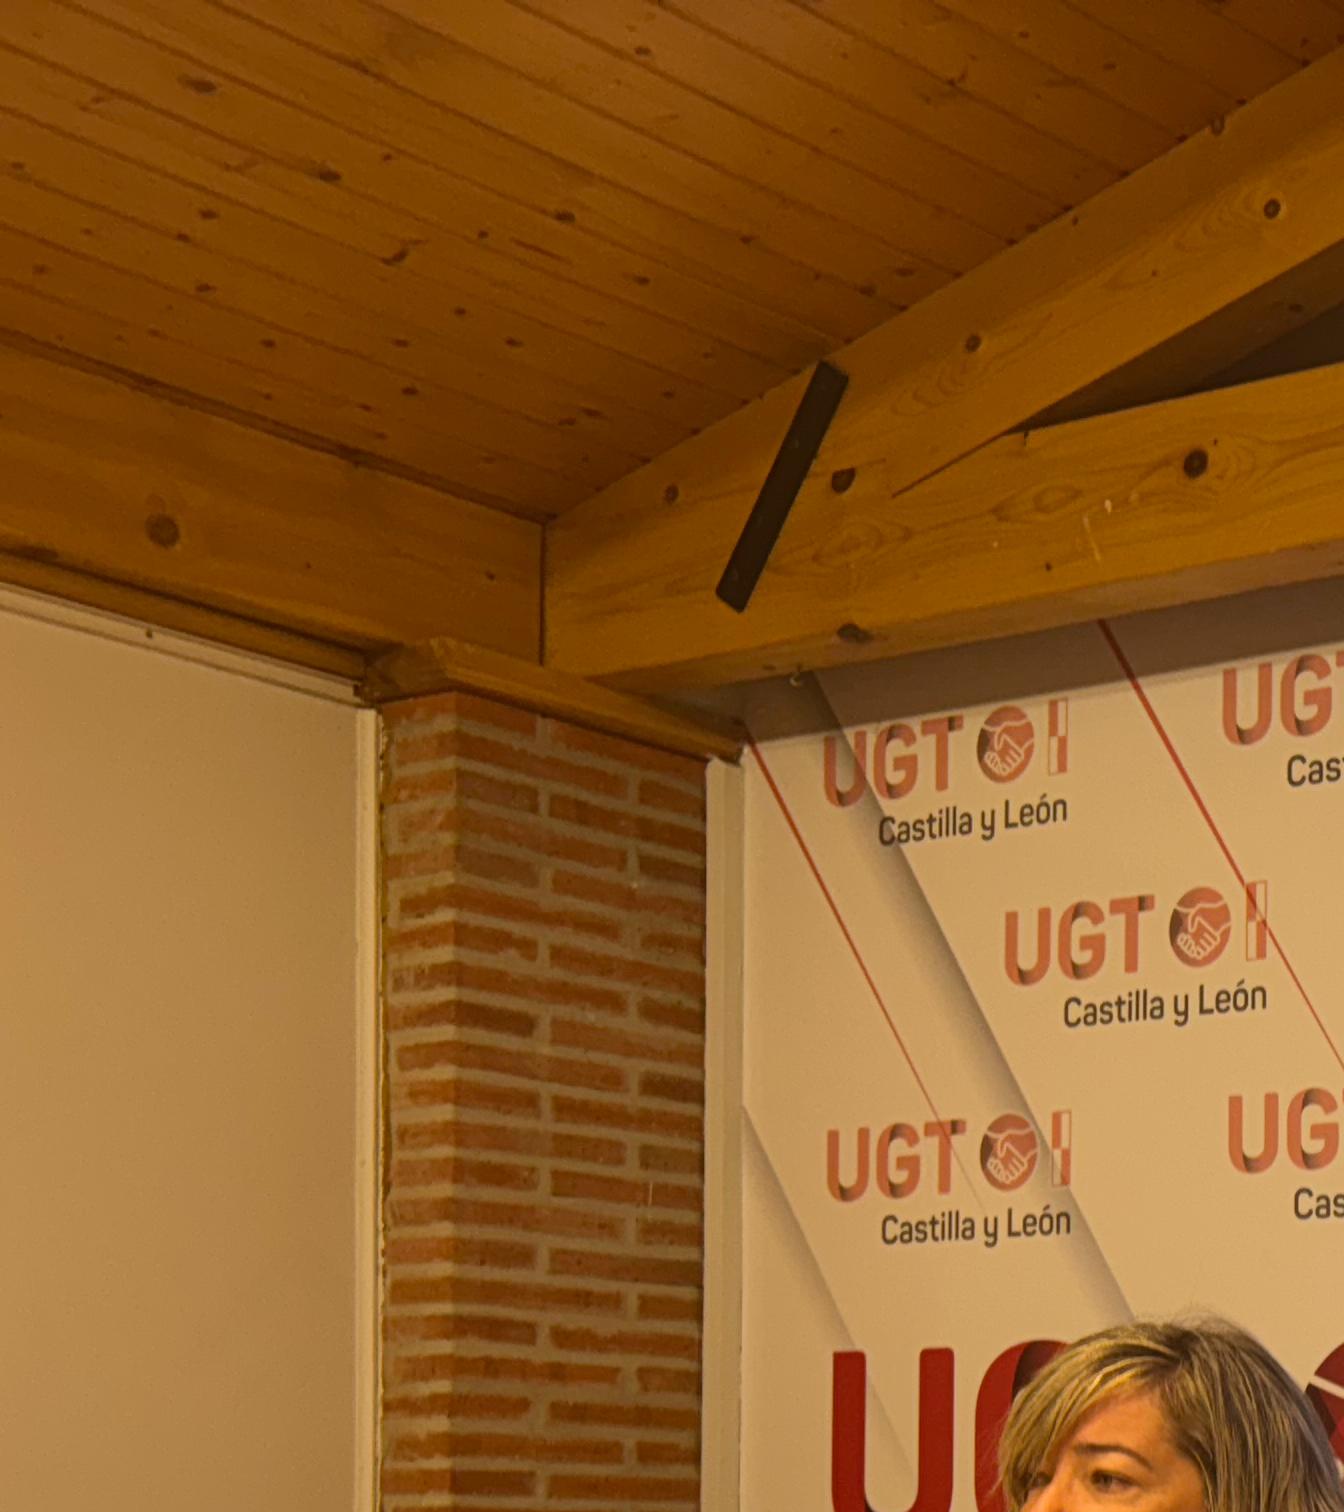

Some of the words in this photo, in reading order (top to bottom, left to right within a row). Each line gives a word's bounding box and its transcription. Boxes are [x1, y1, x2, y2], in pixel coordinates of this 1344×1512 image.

[823, 714, 964, 808] UGT
[878, 805, 973, 846] Castilla
[980, 808, 996, 842] y
[1003, 792, 1068, 830] León
[1003, 894, 1156, 988] UGT
[1062, 989, 1166, 1030] Castilla
[1172, 990, 1191, 1026] y
[1197, 980, 1269, 1018] León
[826, 1118, 967, 1204] UGT
[880, 1208, 976, 1247] Castilla
[983, 1212, 999, 1248] y
[1006, 1204, 1072, 1240] León
